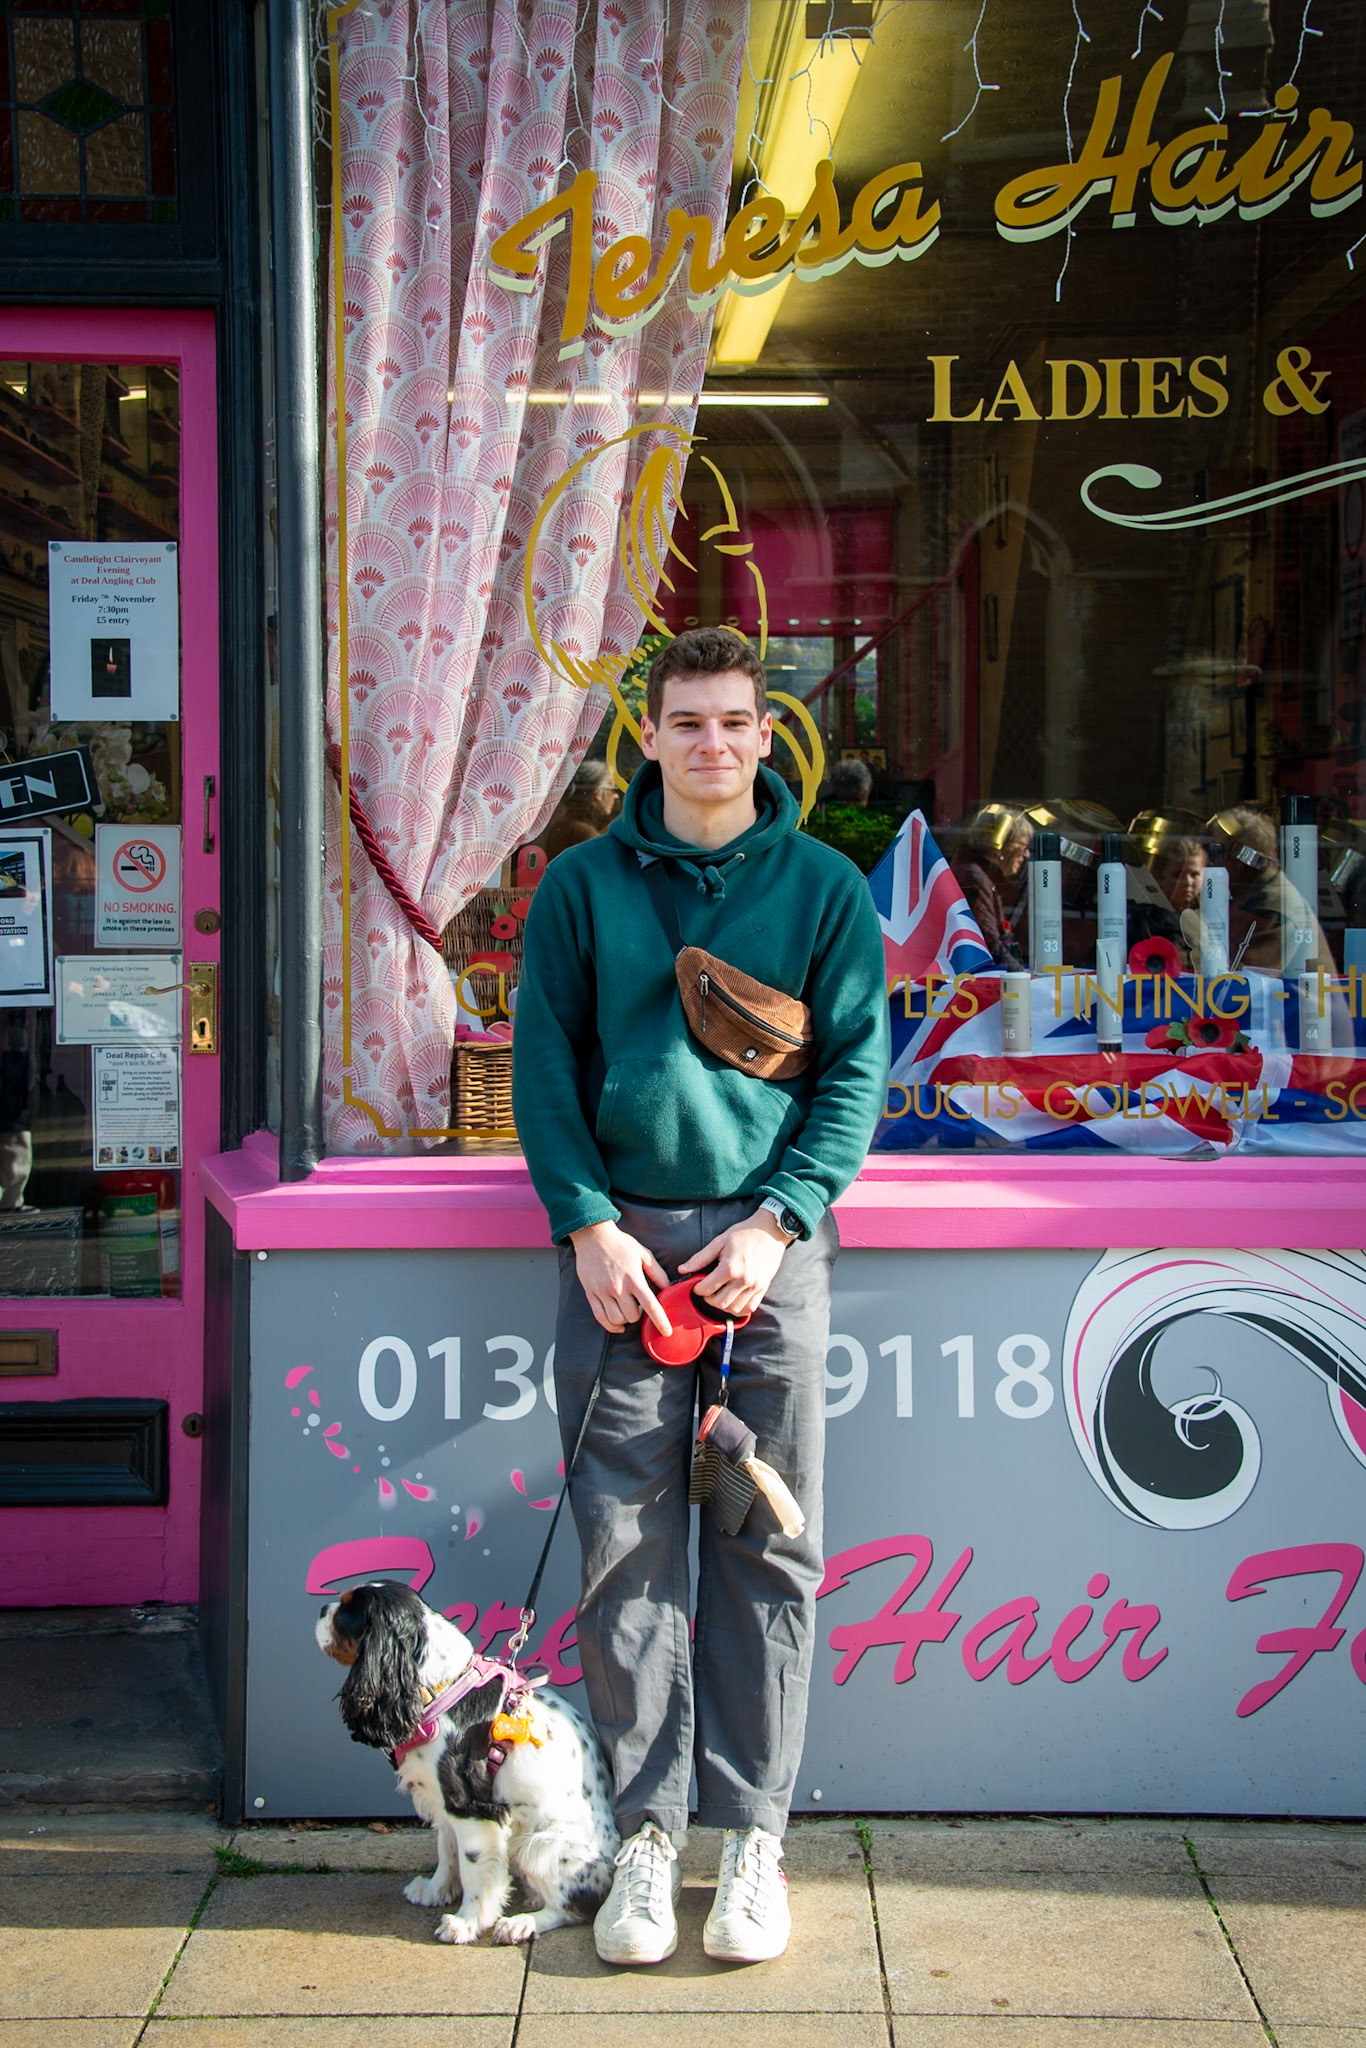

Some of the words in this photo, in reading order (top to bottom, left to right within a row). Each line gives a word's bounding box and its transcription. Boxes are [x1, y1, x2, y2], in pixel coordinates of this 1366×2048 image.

[489, 159, 940, 361] Teresa
[995, 52, 1364, 236] Hair
[926, 354, 1230, 422] LADIES
[1263, 345, 1332, 416] &
[64, 555, 112, 565] Candlelight
[114, 555, 162, 565] Clairvoyant
[97, 566, 131, 576] Evening
[81, 577, 100, 585] Deal
[102, 577, 134, 586] Angling
[136, 577, 156, 585] Club
[72, 595, 98, 605] Friday
[114, 595, 156, 603] November
[98, 606, 129, 616] 7:30pm
[97, 616, 107, 625] £5
[108, 617, 131, 626] entry
[104, 902, 120, 912] NO
[122, 902, 177, 914] SMOKING.
[118, 918, 141, 926] against
[1294, 929, 1313, 944] 53
[1043, 940, 1058, 953] 33
[1042, 965, 1251, 1020] TINTING
[1005, 1029, 1016, 1040] 15
[1305, 1029, 1318, 1040] 44
[124, 1052, 149, 1060] Repair
[1044, 1081, 1279, 1120] GOLDWELL
[358, 1334, 559, 1421] 013
[816, 1535, 1169, 1686] Hair
